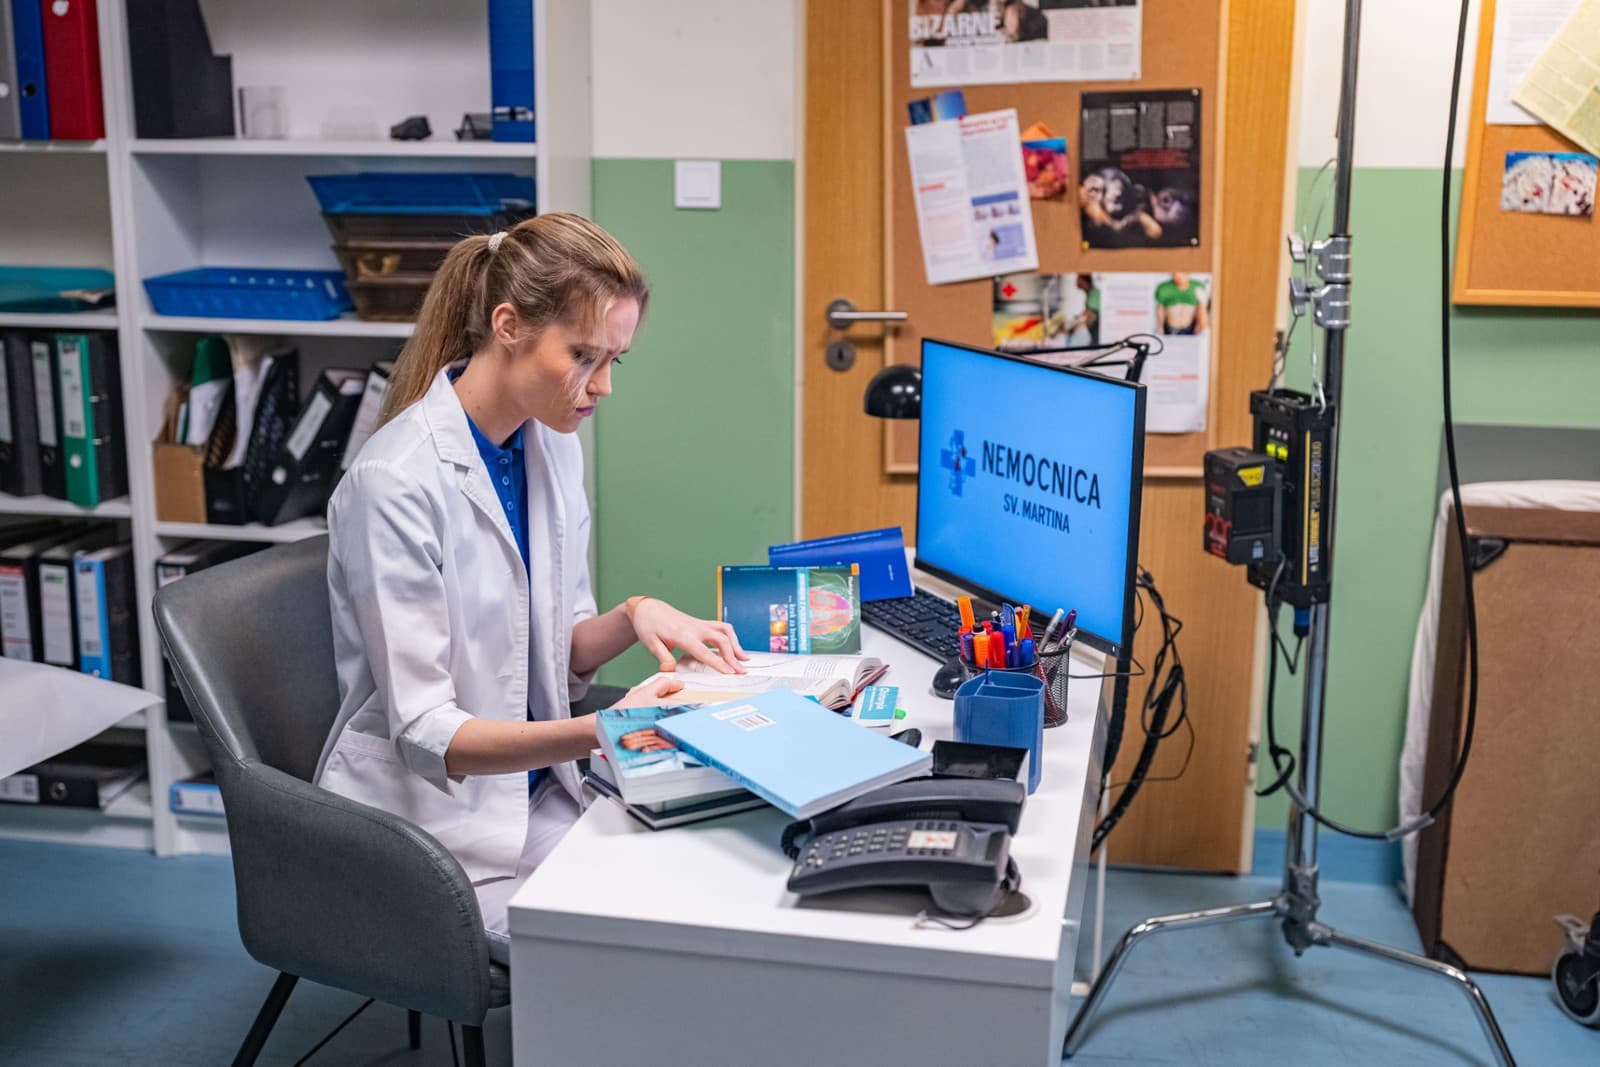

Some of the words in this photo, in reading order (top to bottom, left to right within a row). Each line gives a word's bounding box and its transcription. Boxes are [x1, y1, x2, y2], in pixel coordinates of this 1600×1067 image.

[982, 440, 1101, 509] NEMOCNICA
[1003, 493, 1020, 515] SV.
[1022, 499, 1070, 534] MARTINA
